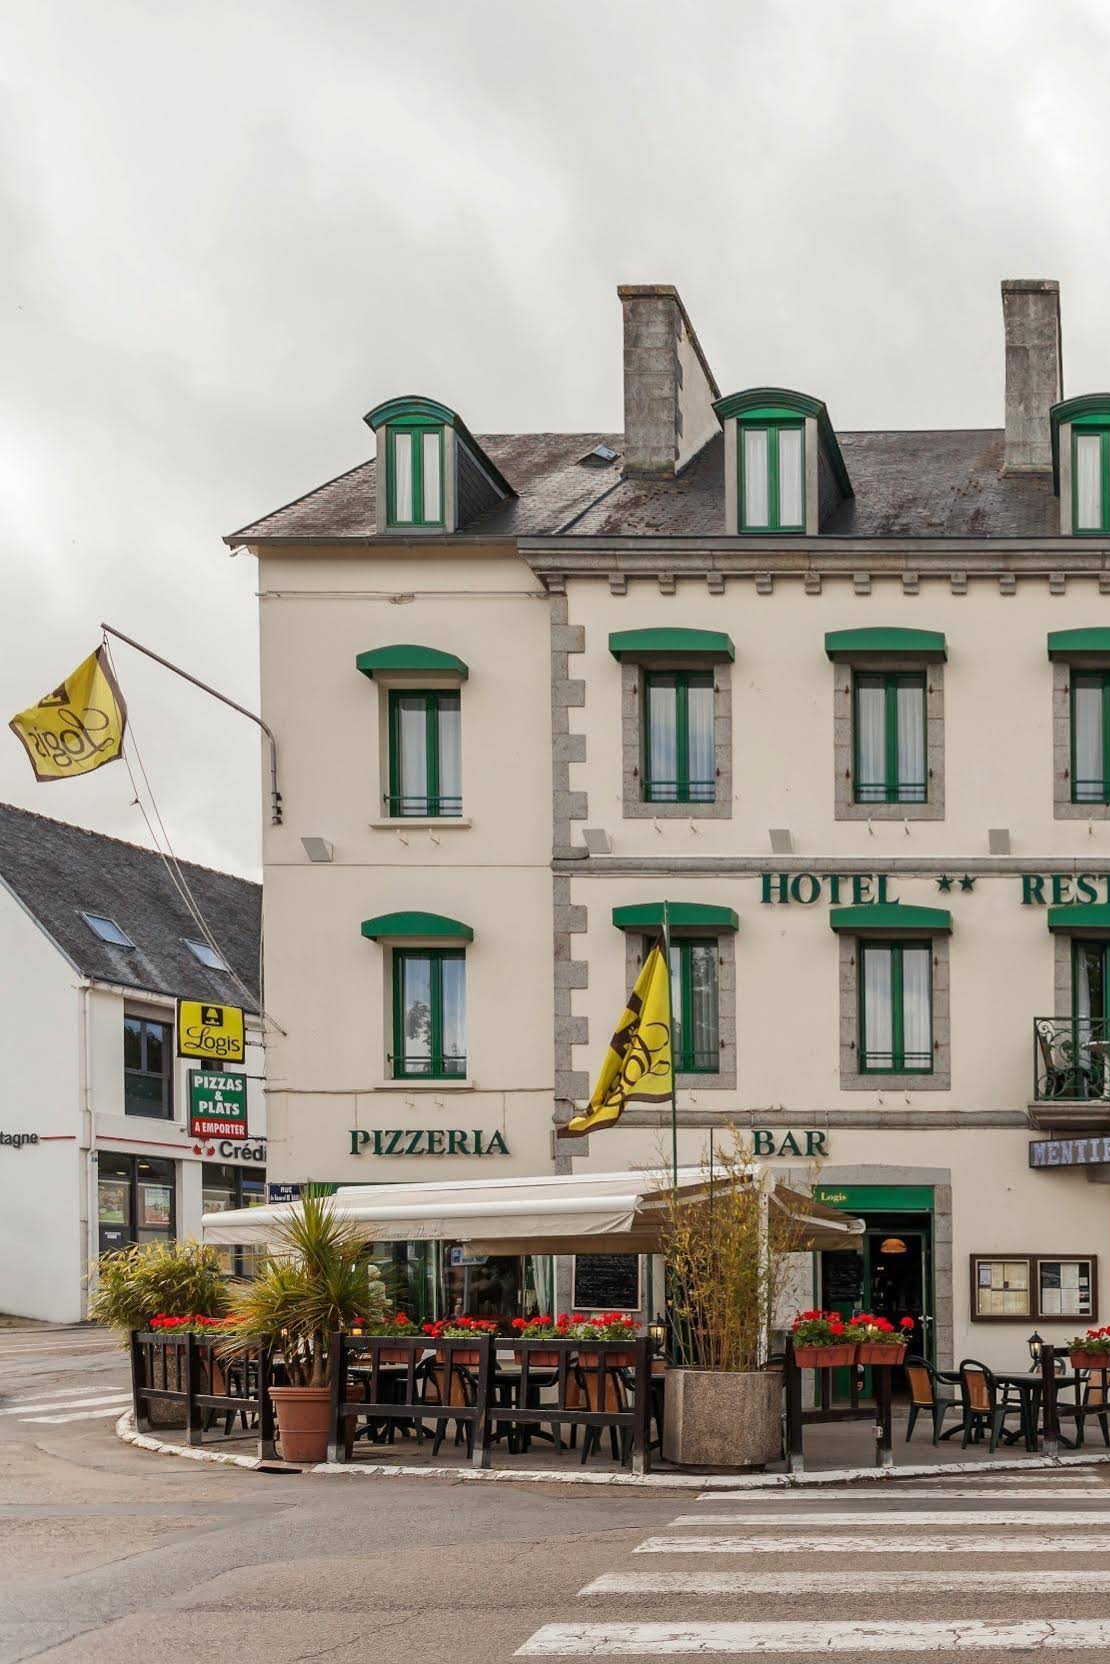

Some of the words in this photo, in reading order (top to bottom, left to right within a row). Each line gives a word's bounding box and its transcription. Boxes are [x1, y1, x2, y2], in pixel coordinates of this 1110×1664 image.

[760, 873, 900, 905] HOTEL
[184, 1026, 241, 1056] Logis
[194, 1076, 243, 1092] PIZZAS
[214, 1091, 223, 1101] &
[198, 1101, 240, 1116] PLATS
[194, 1121, 201, 1132] A
[202, 1121, 245, 1135] EMPORTER
[348, 1129, 511, 1156] PIZZERIA
[751, 1130, 829, 1156] BAR
[820, 1191, 847, 1203] Logis
